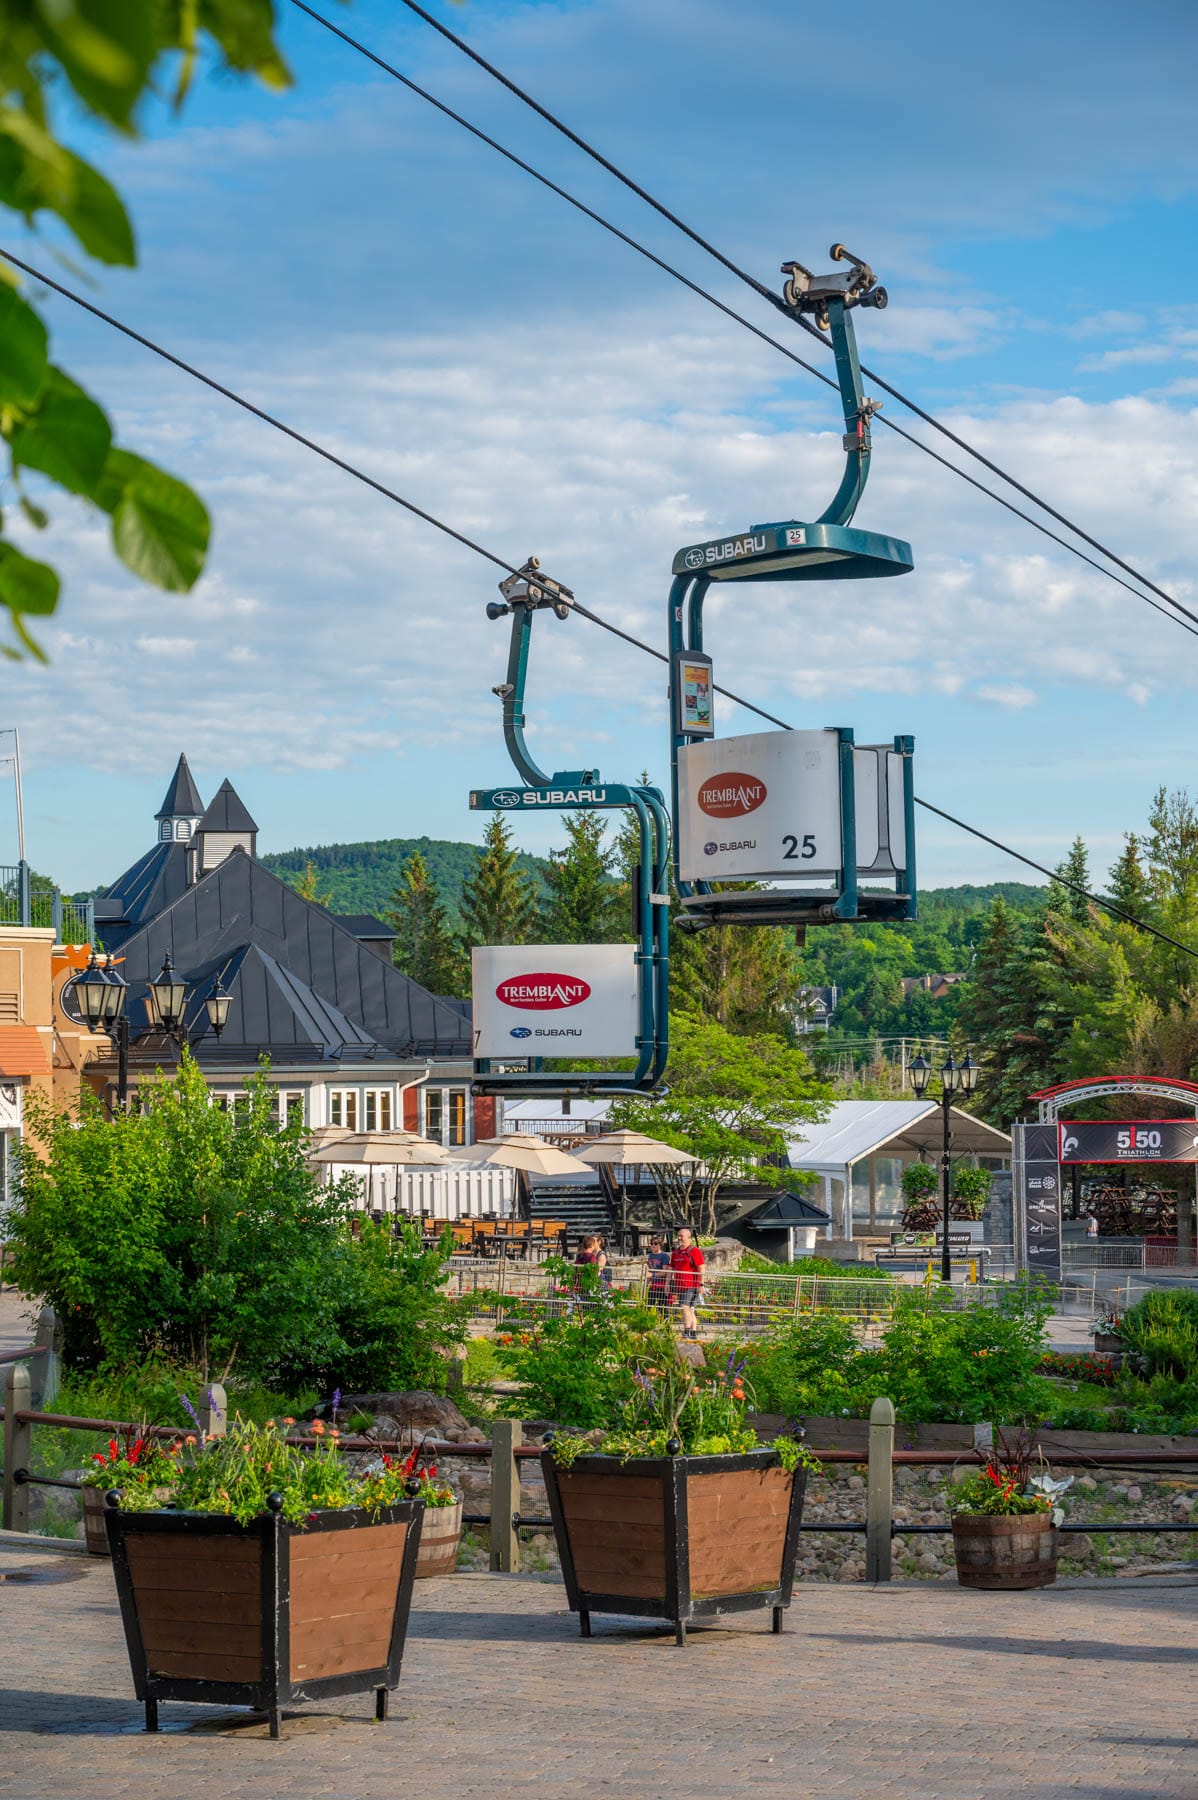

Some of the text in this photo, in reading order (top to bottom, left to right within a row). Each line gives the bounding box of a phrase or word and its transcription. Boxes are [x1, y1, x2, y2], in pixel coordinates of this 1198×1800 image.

[789, 530, 801, 540] 25
[705, 535, 766, 563] SUBARU
[522, 789, 606, 804] SUBARU
[702, 785, 762, 810] TREMBLANT
[719, 840, 757, 852] SUBARU
[781, 834, 817, 860] 25
[502, 984, 585, 1005] TREMBLANT
[534, 1029, 582, 1037] SUBARU
